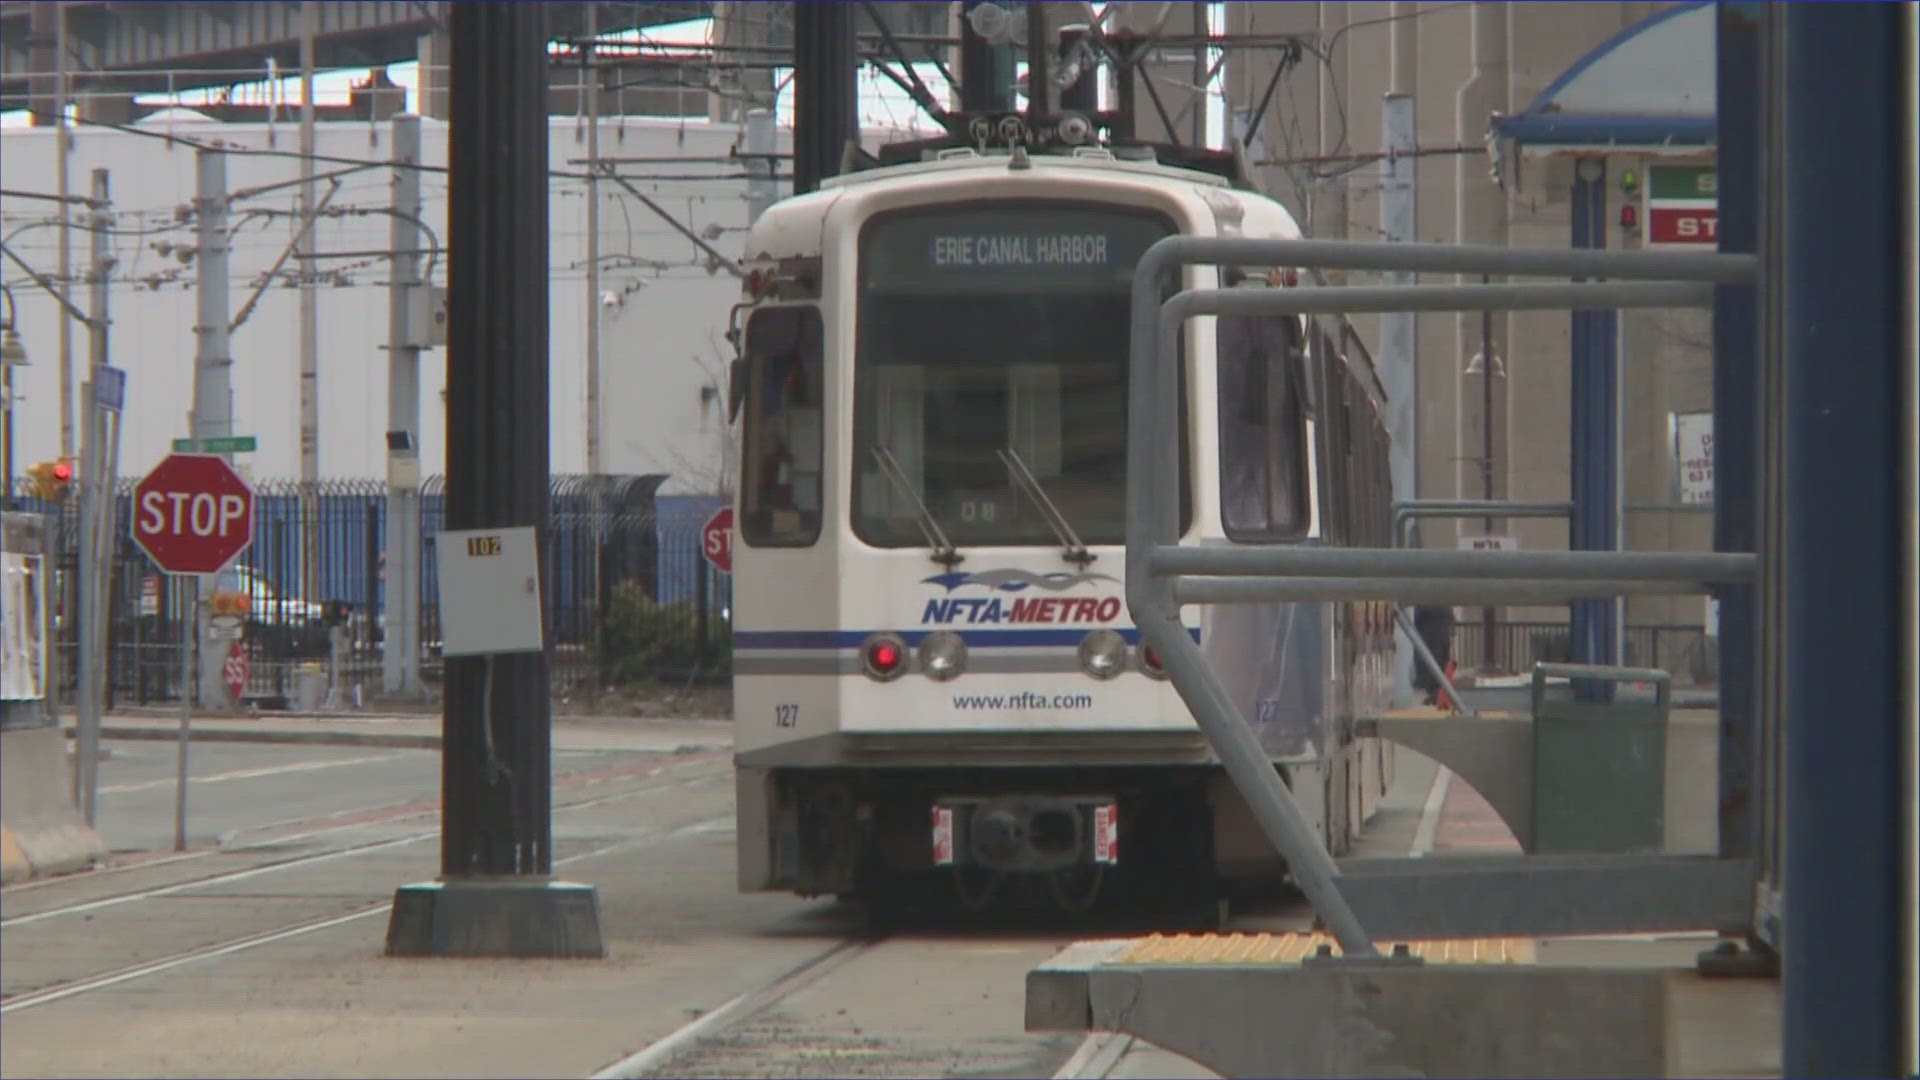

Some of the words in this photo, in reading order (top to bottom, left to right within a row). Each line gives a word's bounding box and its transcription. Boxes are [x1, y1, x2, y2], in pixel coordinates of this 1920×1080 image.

[935, 236, 973, 265] ERIE
[977, 236, 1033, 264] CANAL
[1037, 235, 1107, 264] HARBOR
[140, 490, 245, 537] STOP
[471, 538, 501, 556] 102
[921, 597, 1121, 625] NFTA-METRO
[953, 692, 1092, 710] www.nfta.com
[776, 704, 799, 728] 127
